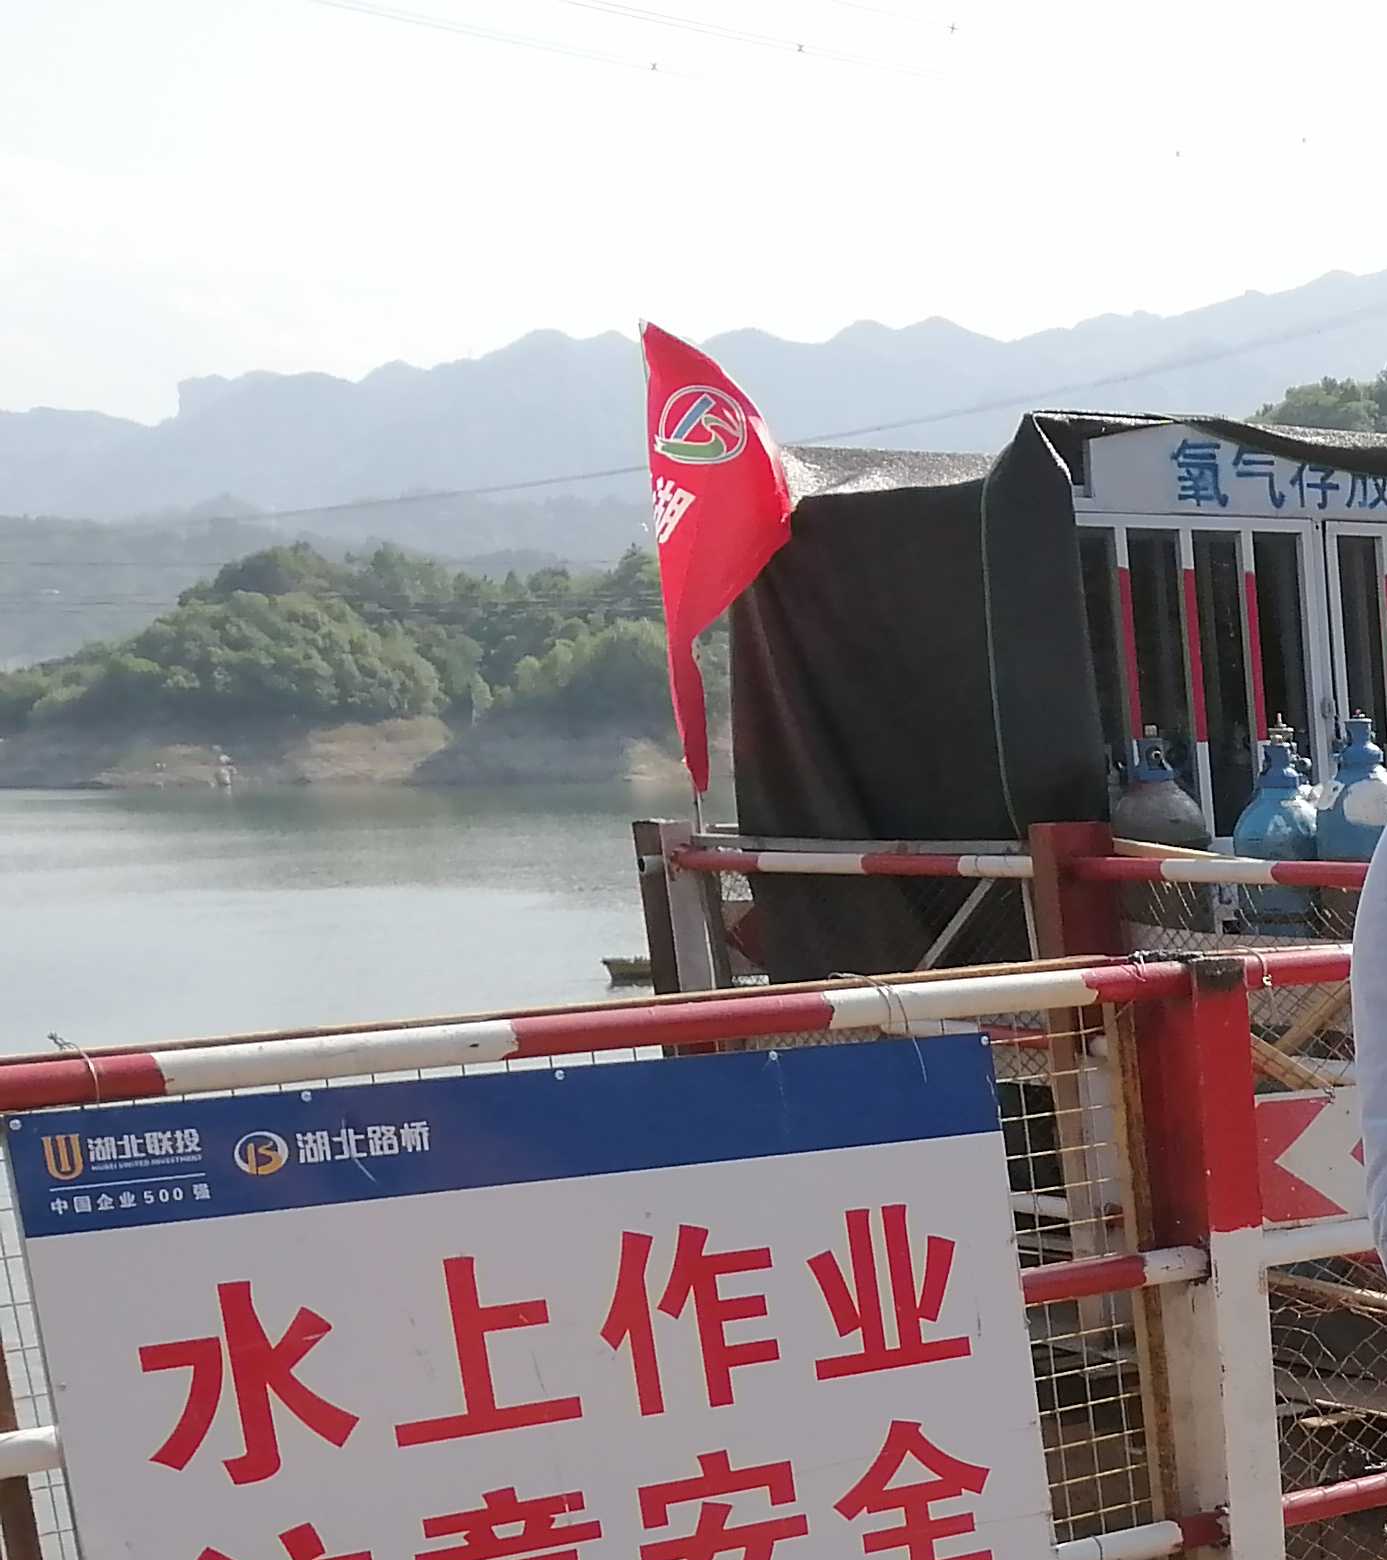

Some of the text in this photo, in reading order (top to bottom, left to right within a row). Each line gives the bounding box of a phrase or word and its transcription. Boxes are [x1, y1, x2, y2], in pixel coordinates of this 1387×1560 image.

[86, 1128, 202, 1162] 湖北联投
[295, 1120, 431, 1164] 湖北路桥
[138, 1203, 972, 1486] 水上作业
